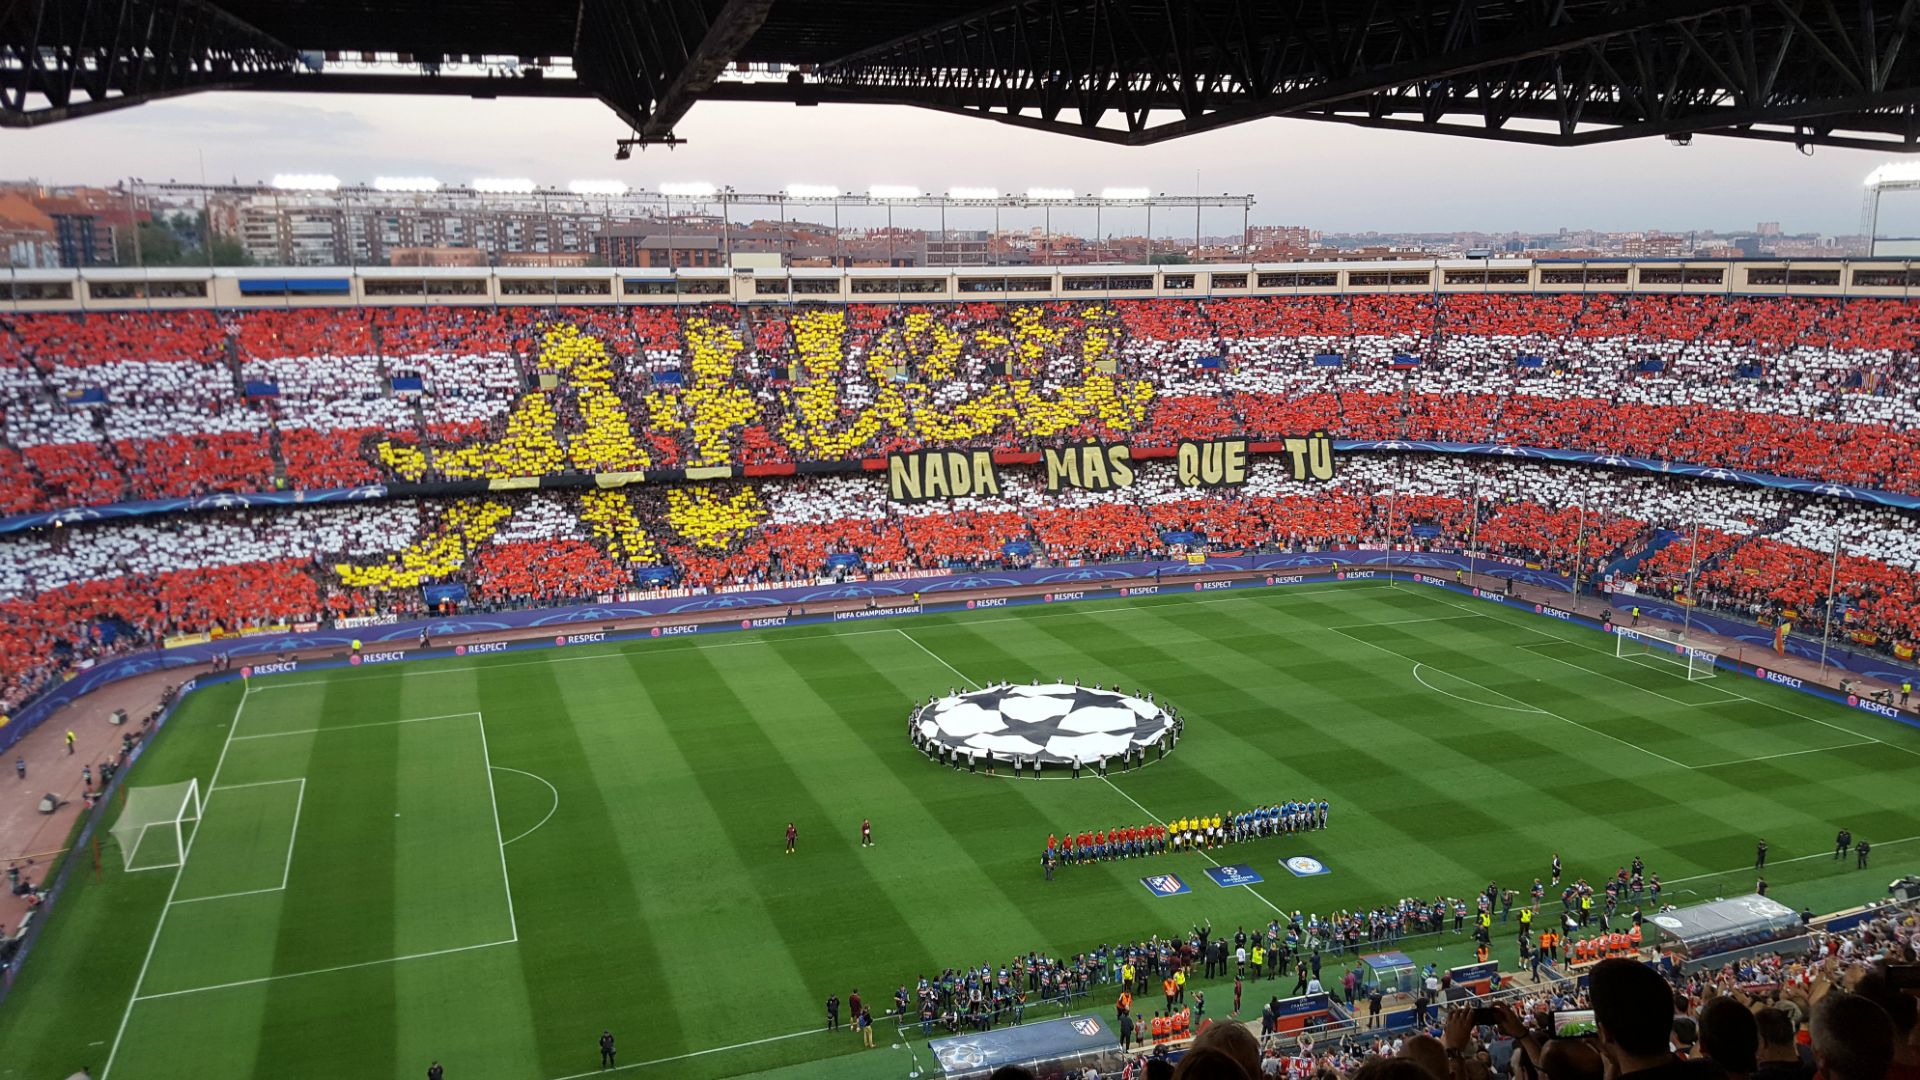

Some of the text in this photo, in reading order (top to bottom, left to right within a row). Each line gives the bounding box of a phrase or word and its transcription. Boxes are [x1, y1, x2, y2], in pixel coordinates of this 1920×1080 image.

[890, 432, 1333, 500] NADA MÁS QUE TÚ
[1276, 575, 1304, 584] RESPECT
[1347, 570, 1375, 579] RESPECT
[721, 582, 751, 594] SANTA
[752, 581, 770, 592] ANA
[772, 580, 784, 590] DE
[785, 579, 809, 589] PUSA
[1203, 580, 1232, 589] RESPECT
[1422, 575, 1446, 587] RESPECT
[628, 587, 690, 601] MIGUELTURRA
[1054, 592, 1084, 600] RESPECT
[1130, 586, 1159, 595] RESPECT
[1479, 590, 1504, 602] RESPECT
[976, 598, 1007, 607] RESPECT
[837, 606, 920, 620] UEFA CHAMPIONS LEAGUE
[1543, 606, 1571, 620] RESPECT
[752, 617, 787, 627] RESPECT
[663, 625, 699, 635] RESPECT
[1612, 625, 1640, 640] RSPECT
[568, 633, 606, 643] RESPECT
[468, 642, 508, 653] RESPECT
[363, 651, 405, 663] RESPECT
[1685, 646, 1716, 663] RSPECT
[253, 661, 298, 674] RESPECT
[1766, 671, 1803, 688] RESPECT
[1859, 698, 1900, 718] RESPECT
